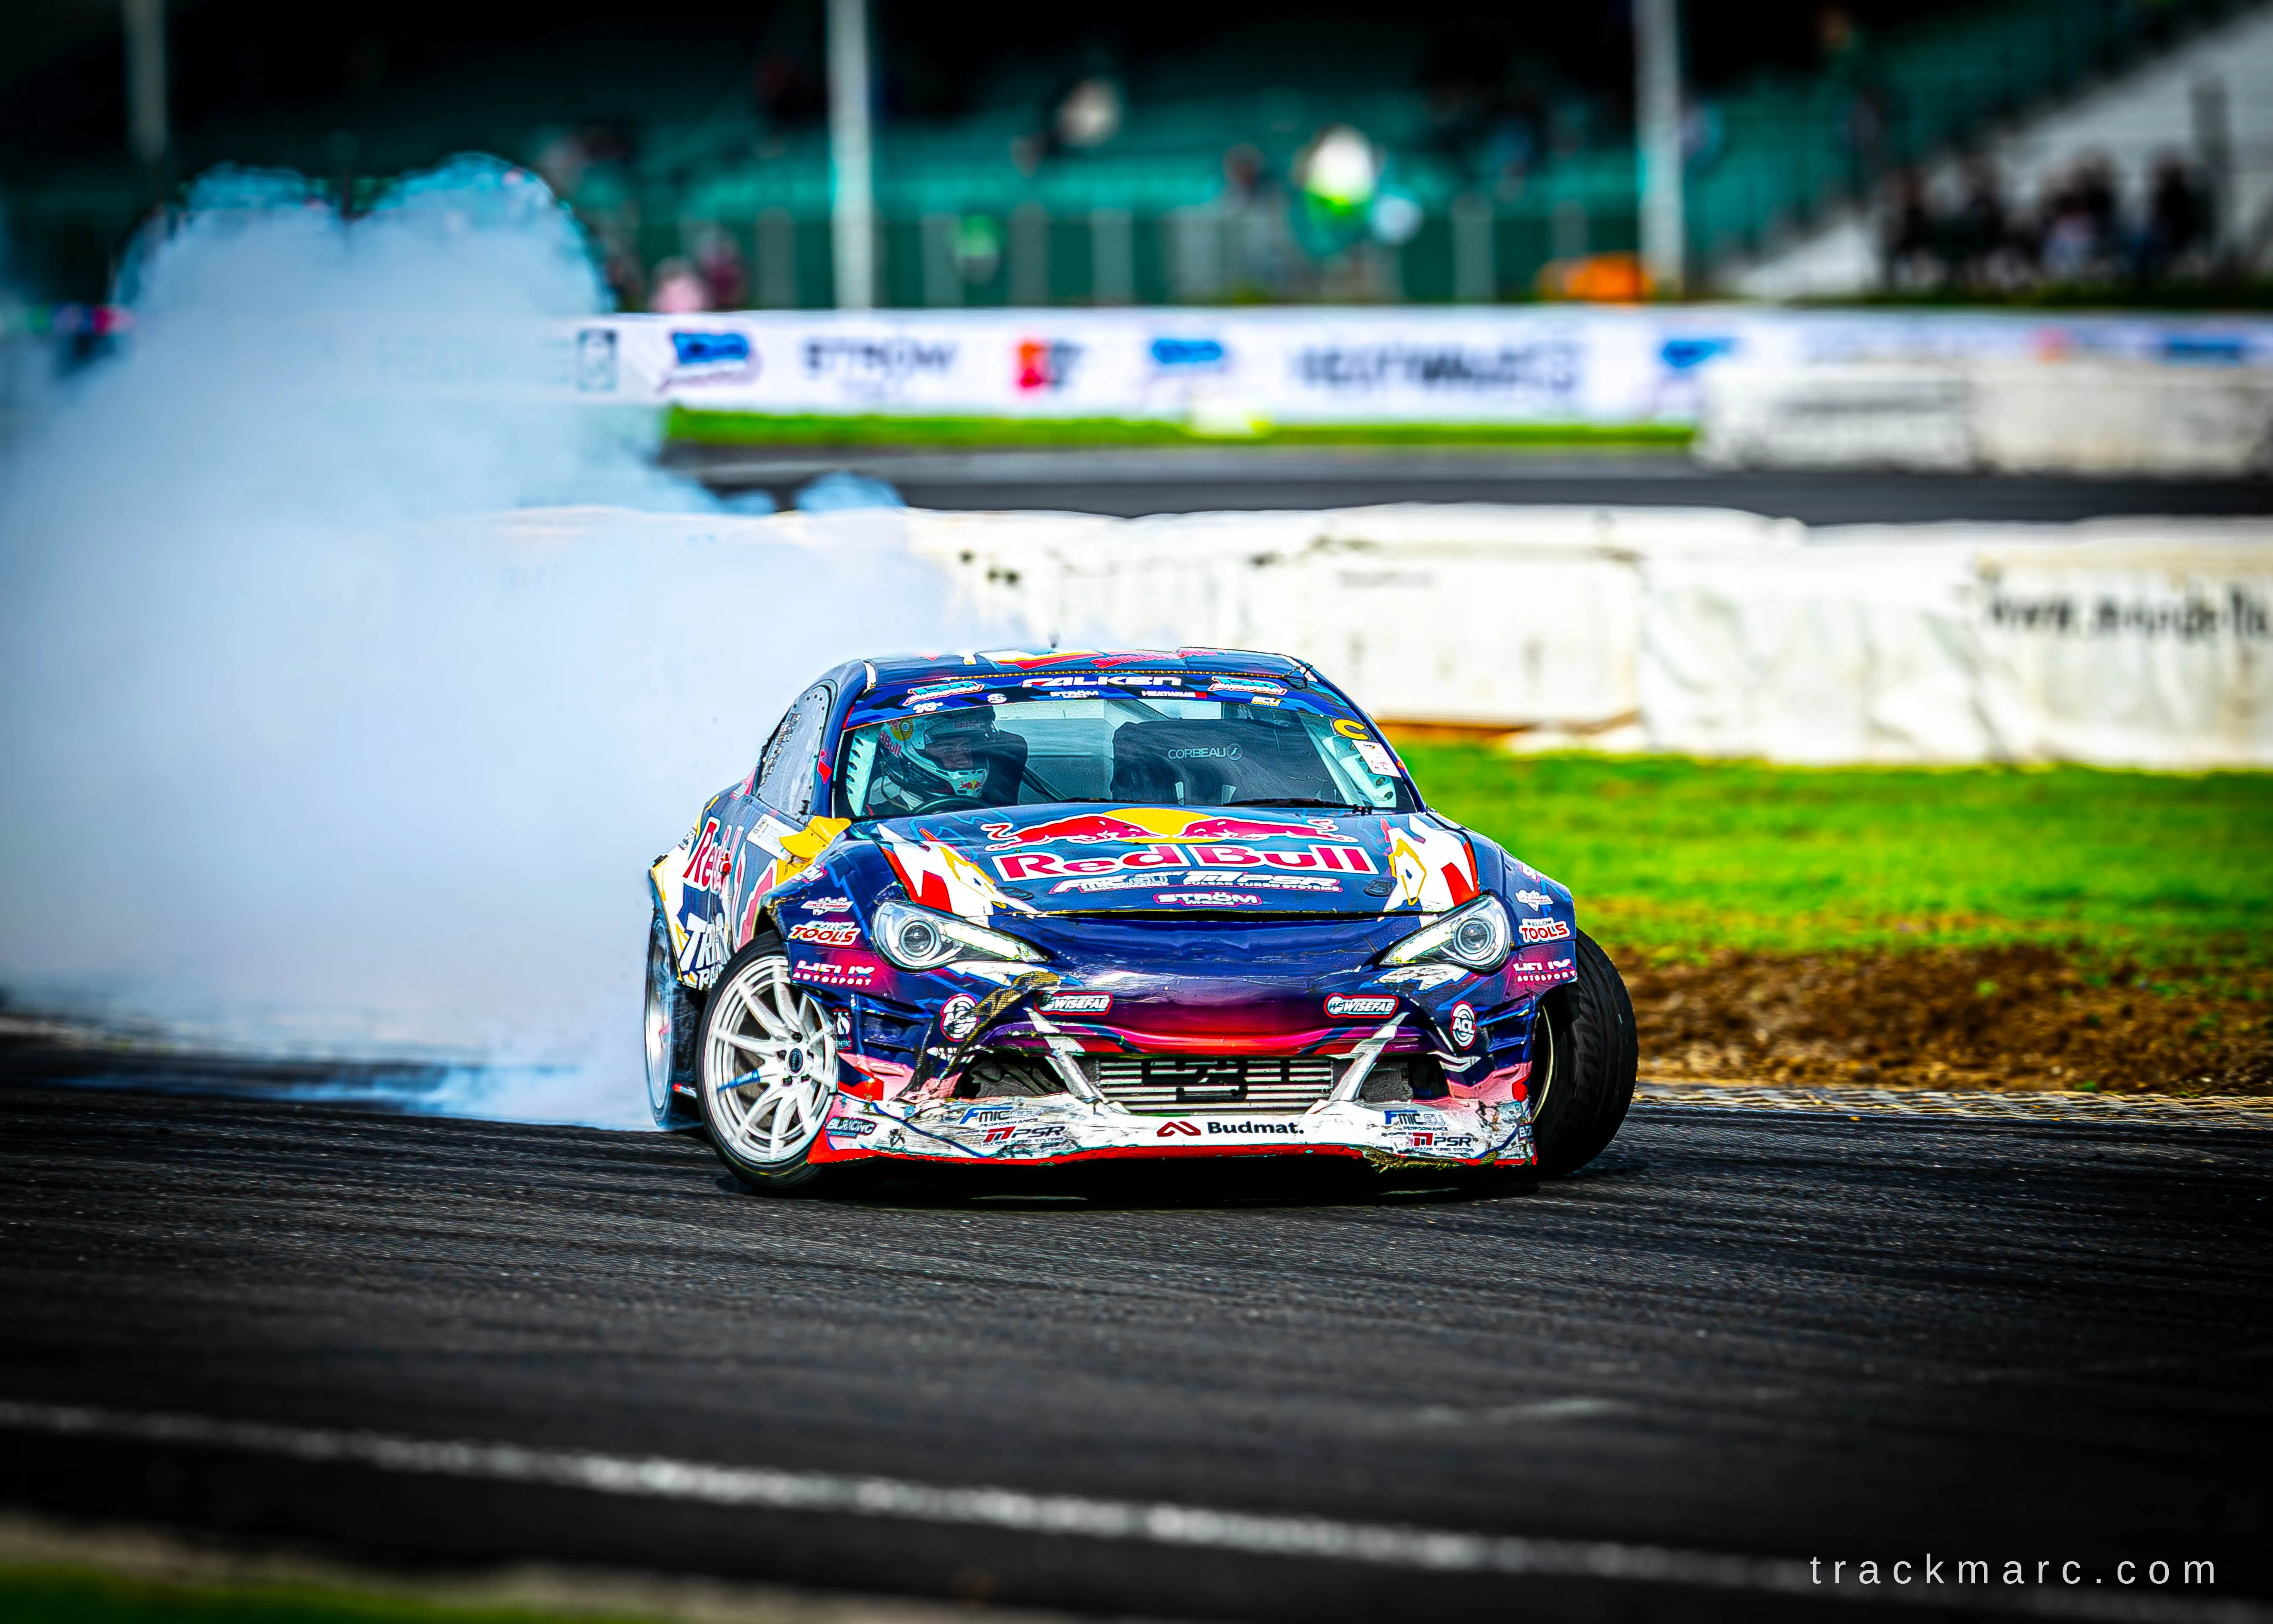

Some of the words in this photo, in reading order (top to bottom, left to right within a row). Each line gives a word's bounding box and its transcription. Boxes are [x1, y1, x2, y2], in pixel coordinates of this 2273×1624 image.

[1022, 676, 1182, 687] FALKEN
[1334, 719, 1369, 740] C
[1168, 747, 1226, 759] CORBEAU
[996, 845, 1182, 880] Red
[1196, 846, 1376, 873] Bull
[1237, 874, 1339, 886] PSR
[1157, 891, 1258, 903] STRÖM
[791, 927, 858, 942] TOOLS
[1521, 924, 1567, 940] TOOLS
[792, 972, 872, 986] AUTOSPORT
[1517, 970, 1576, 982] AUTOSPORT
[1054, 998, 1110, 1009] WISEFAB
[1343, 1001, 1395, 1012] WISEFAB
[1452, 1018, 1475, 1034] ACL
[1011, 1126, 1066, 1138] PSR
[1207, 1121, 1304, 1134] Budmat.
[1433, 1136, 1473, 1147] PSR
